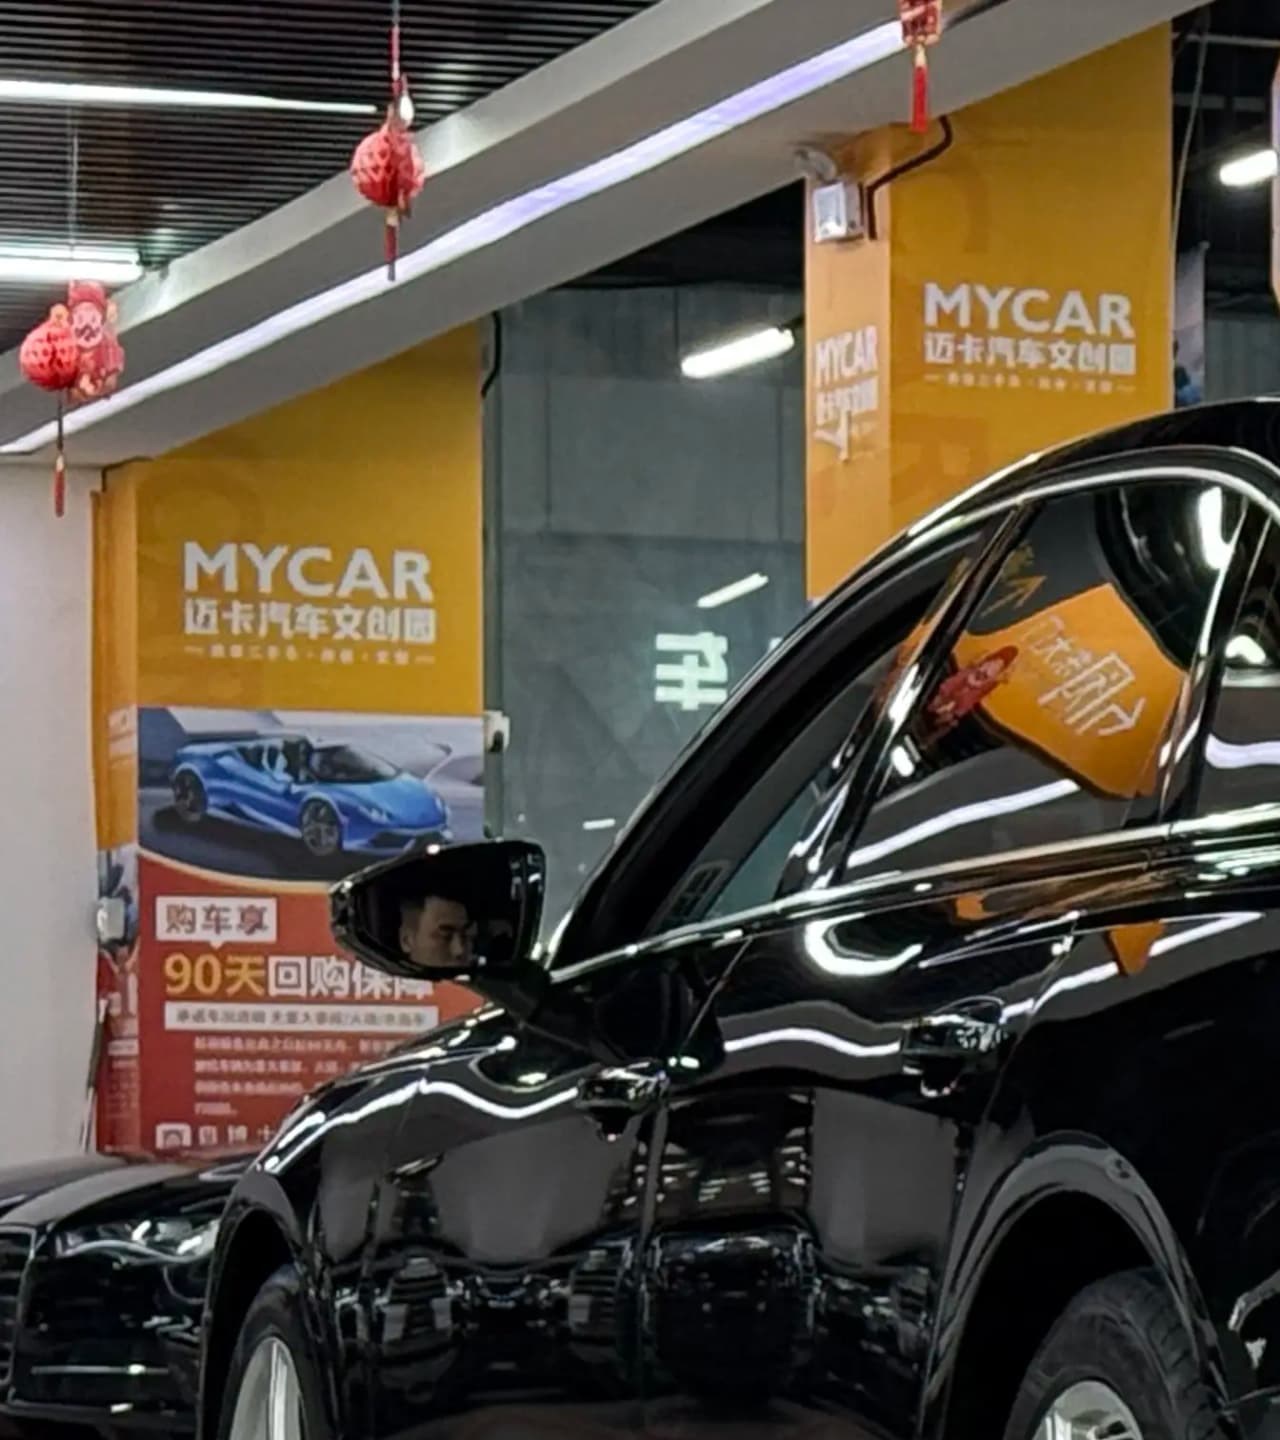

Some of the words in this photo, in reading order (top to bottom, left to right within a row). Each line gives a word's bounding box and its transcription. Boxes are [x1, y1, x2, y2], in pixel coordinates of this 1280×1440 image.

[924, 282, 1135, 338] MYCAR
[814, 325, 878, 388] MYCAR
[924, 331, 1136, 376] 迈卡汽车文创园
[184, 541, 434, 602] MYCAR
[184, 598, 437, 644] 迈卡汽车文创园
[165, 904, 270, 936] 购车享
